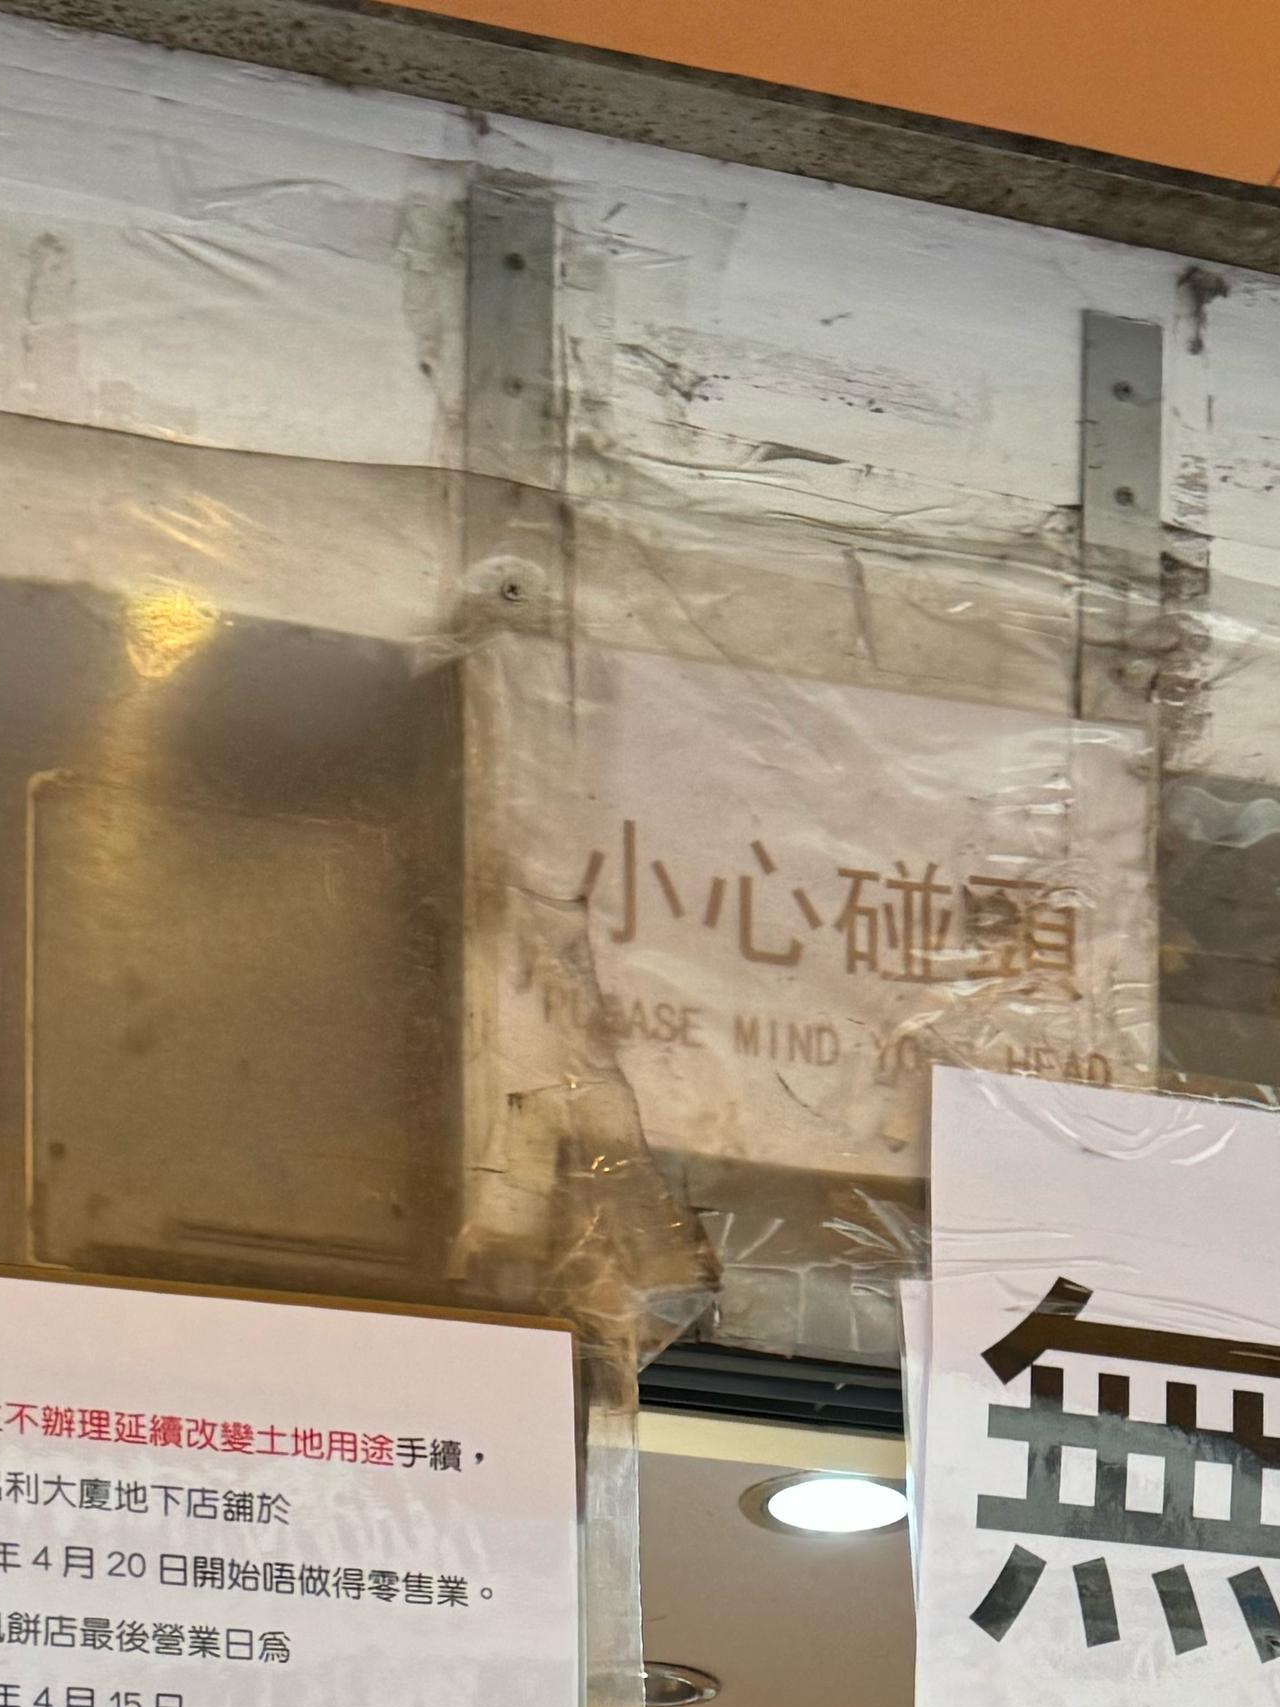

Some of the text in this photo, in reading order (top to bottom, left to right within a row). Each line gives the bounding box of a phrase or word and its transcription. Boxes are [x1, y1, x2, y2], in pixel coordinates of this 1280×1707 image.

[578, 819, 1083, 1000] 小心碰頭
[734, 1014, 840, 1066] MIND
[32, 1544, 53, 1573] 4
[62, 1543, 95, 1581] 月
[107, 1550, 147, 1580] 20
